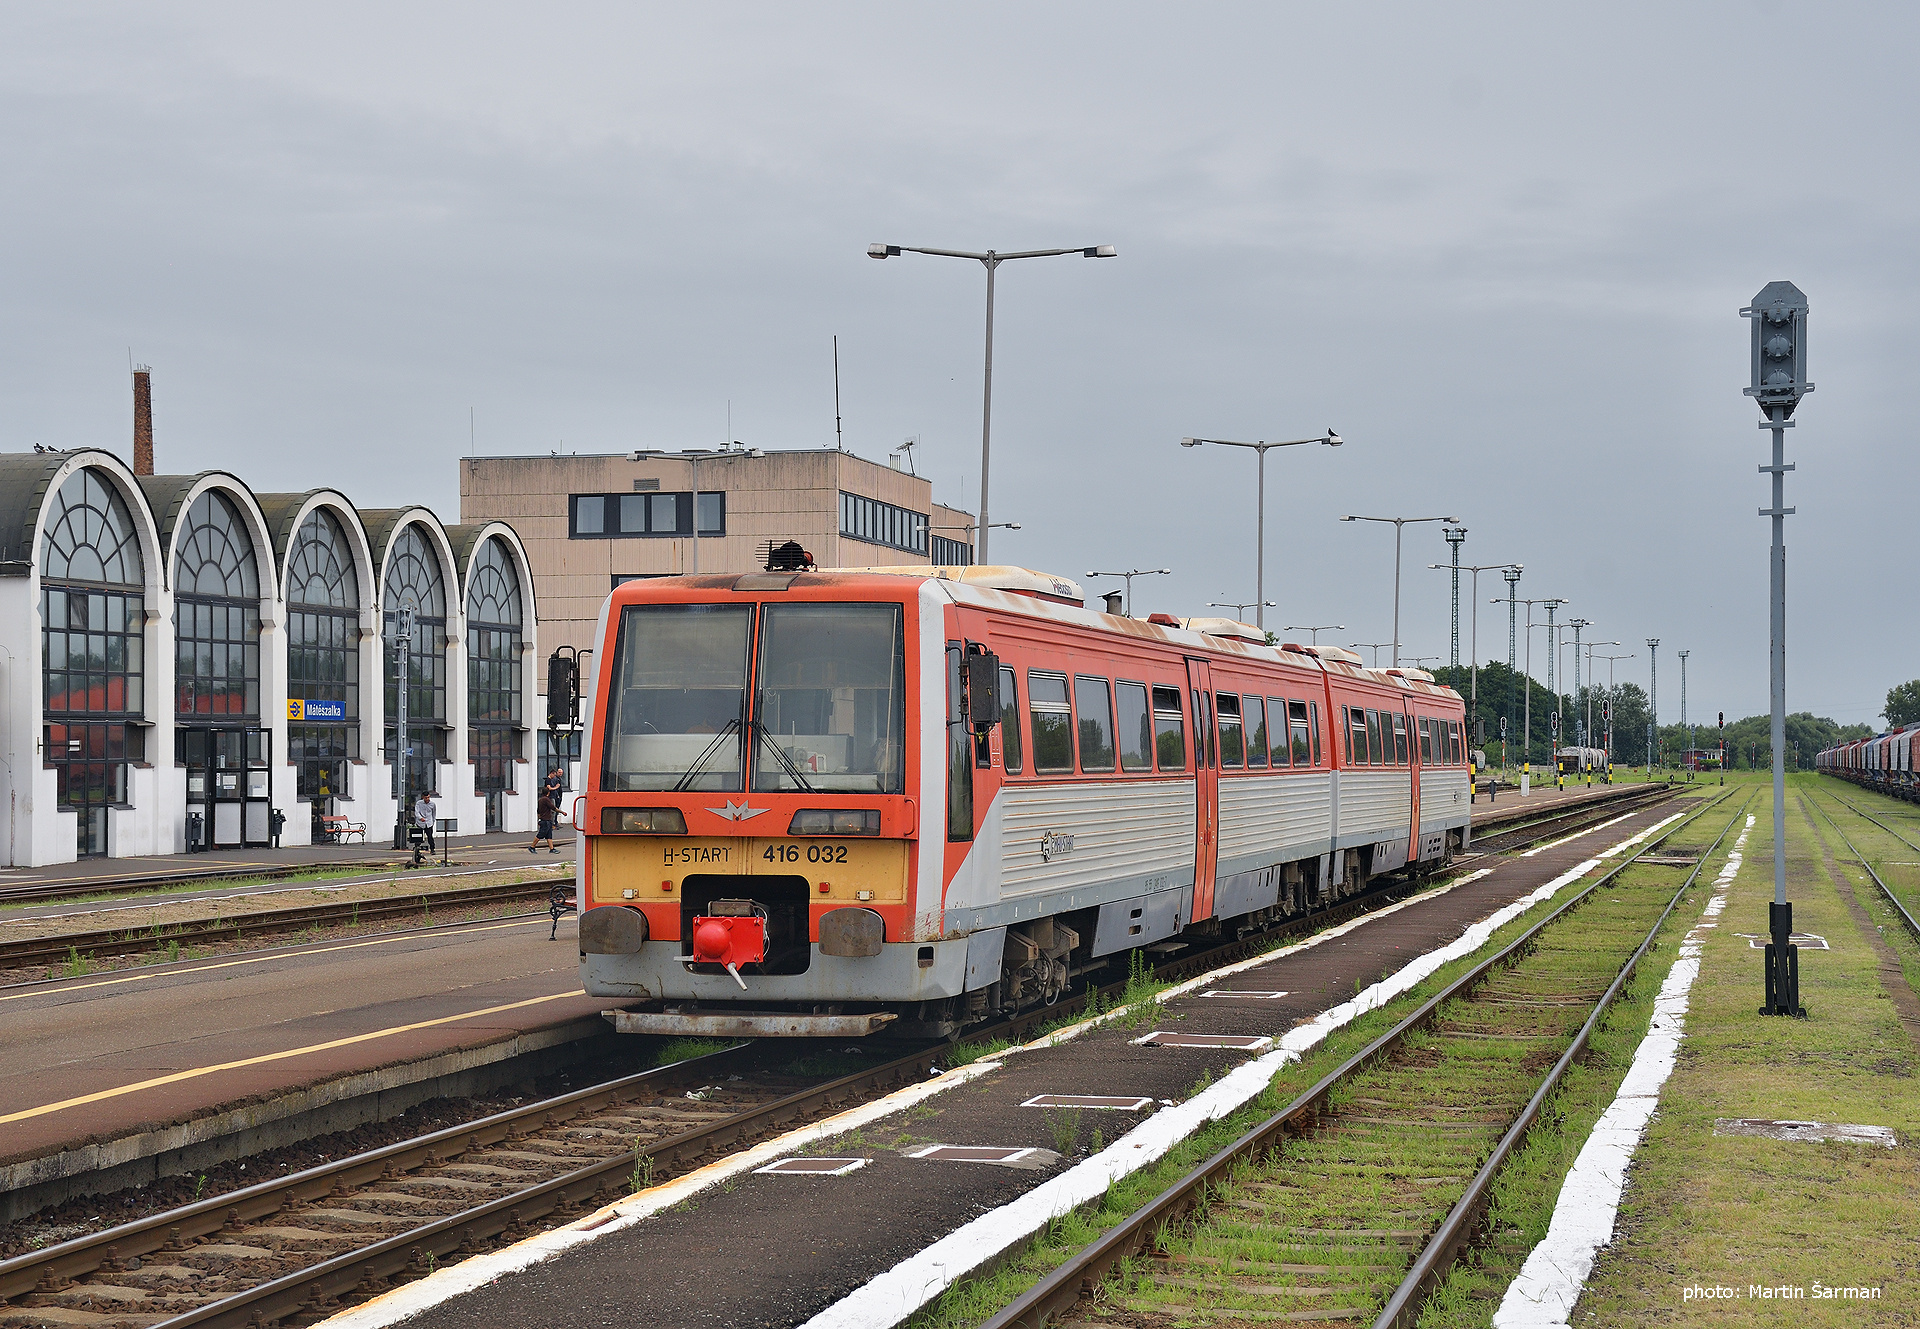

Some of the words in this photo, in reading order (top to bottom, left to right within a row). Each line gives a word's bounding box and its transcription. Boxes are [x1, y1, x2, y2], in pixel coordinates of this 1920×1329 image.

[306, 703, 341, 717] Mátészalka
[663, 847, 732, 867] H-START
[763, 844, 800, 864] 416
[807, 845, 848, 864] 032
